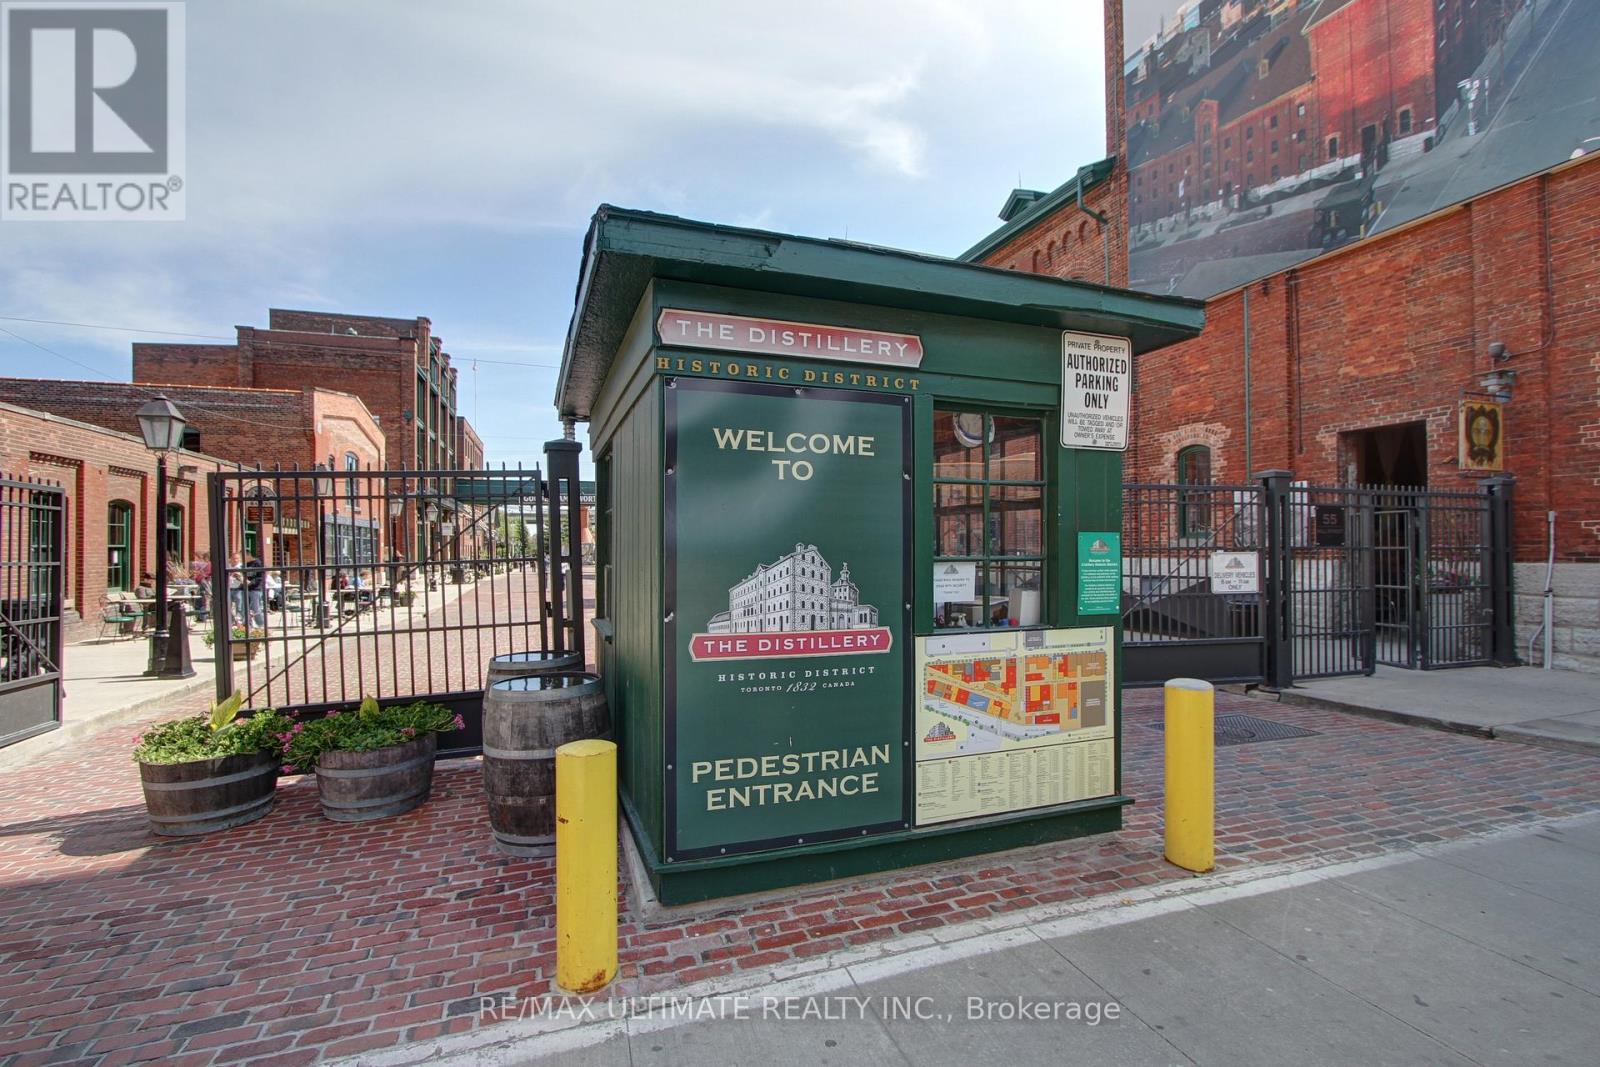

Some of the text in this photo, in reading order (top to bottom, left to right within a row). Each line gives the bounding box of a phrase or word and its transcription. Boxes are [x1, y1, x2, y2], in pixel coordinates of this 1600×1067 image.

[676, 319, 909, 357] THE DISTILLERY
[1067, 340, 1126, 354] PRIVATE PROPERTY
[656, 357, 920, 390] HISTORIC DISTRICT
[1067, 353, 1127, 375] AUTHORIZED
[1075, 373, 1119, 392] PARKING
[1084, 392, 1109, 409] ONLY
[713, 427, 875, 457] WELCOME
[771, 460, 814, 481] TO
[704, 634, 881, 653] THE DISTILLERY
[718, 666, 876, 682] HISTORIC DISTRICT
[740, 681, 855, 694] TORONTO 1832 CANADA
[691, 743, 891, 784] PEDESTRIAN
[706, 772, 879, 811] ENTRANCE
